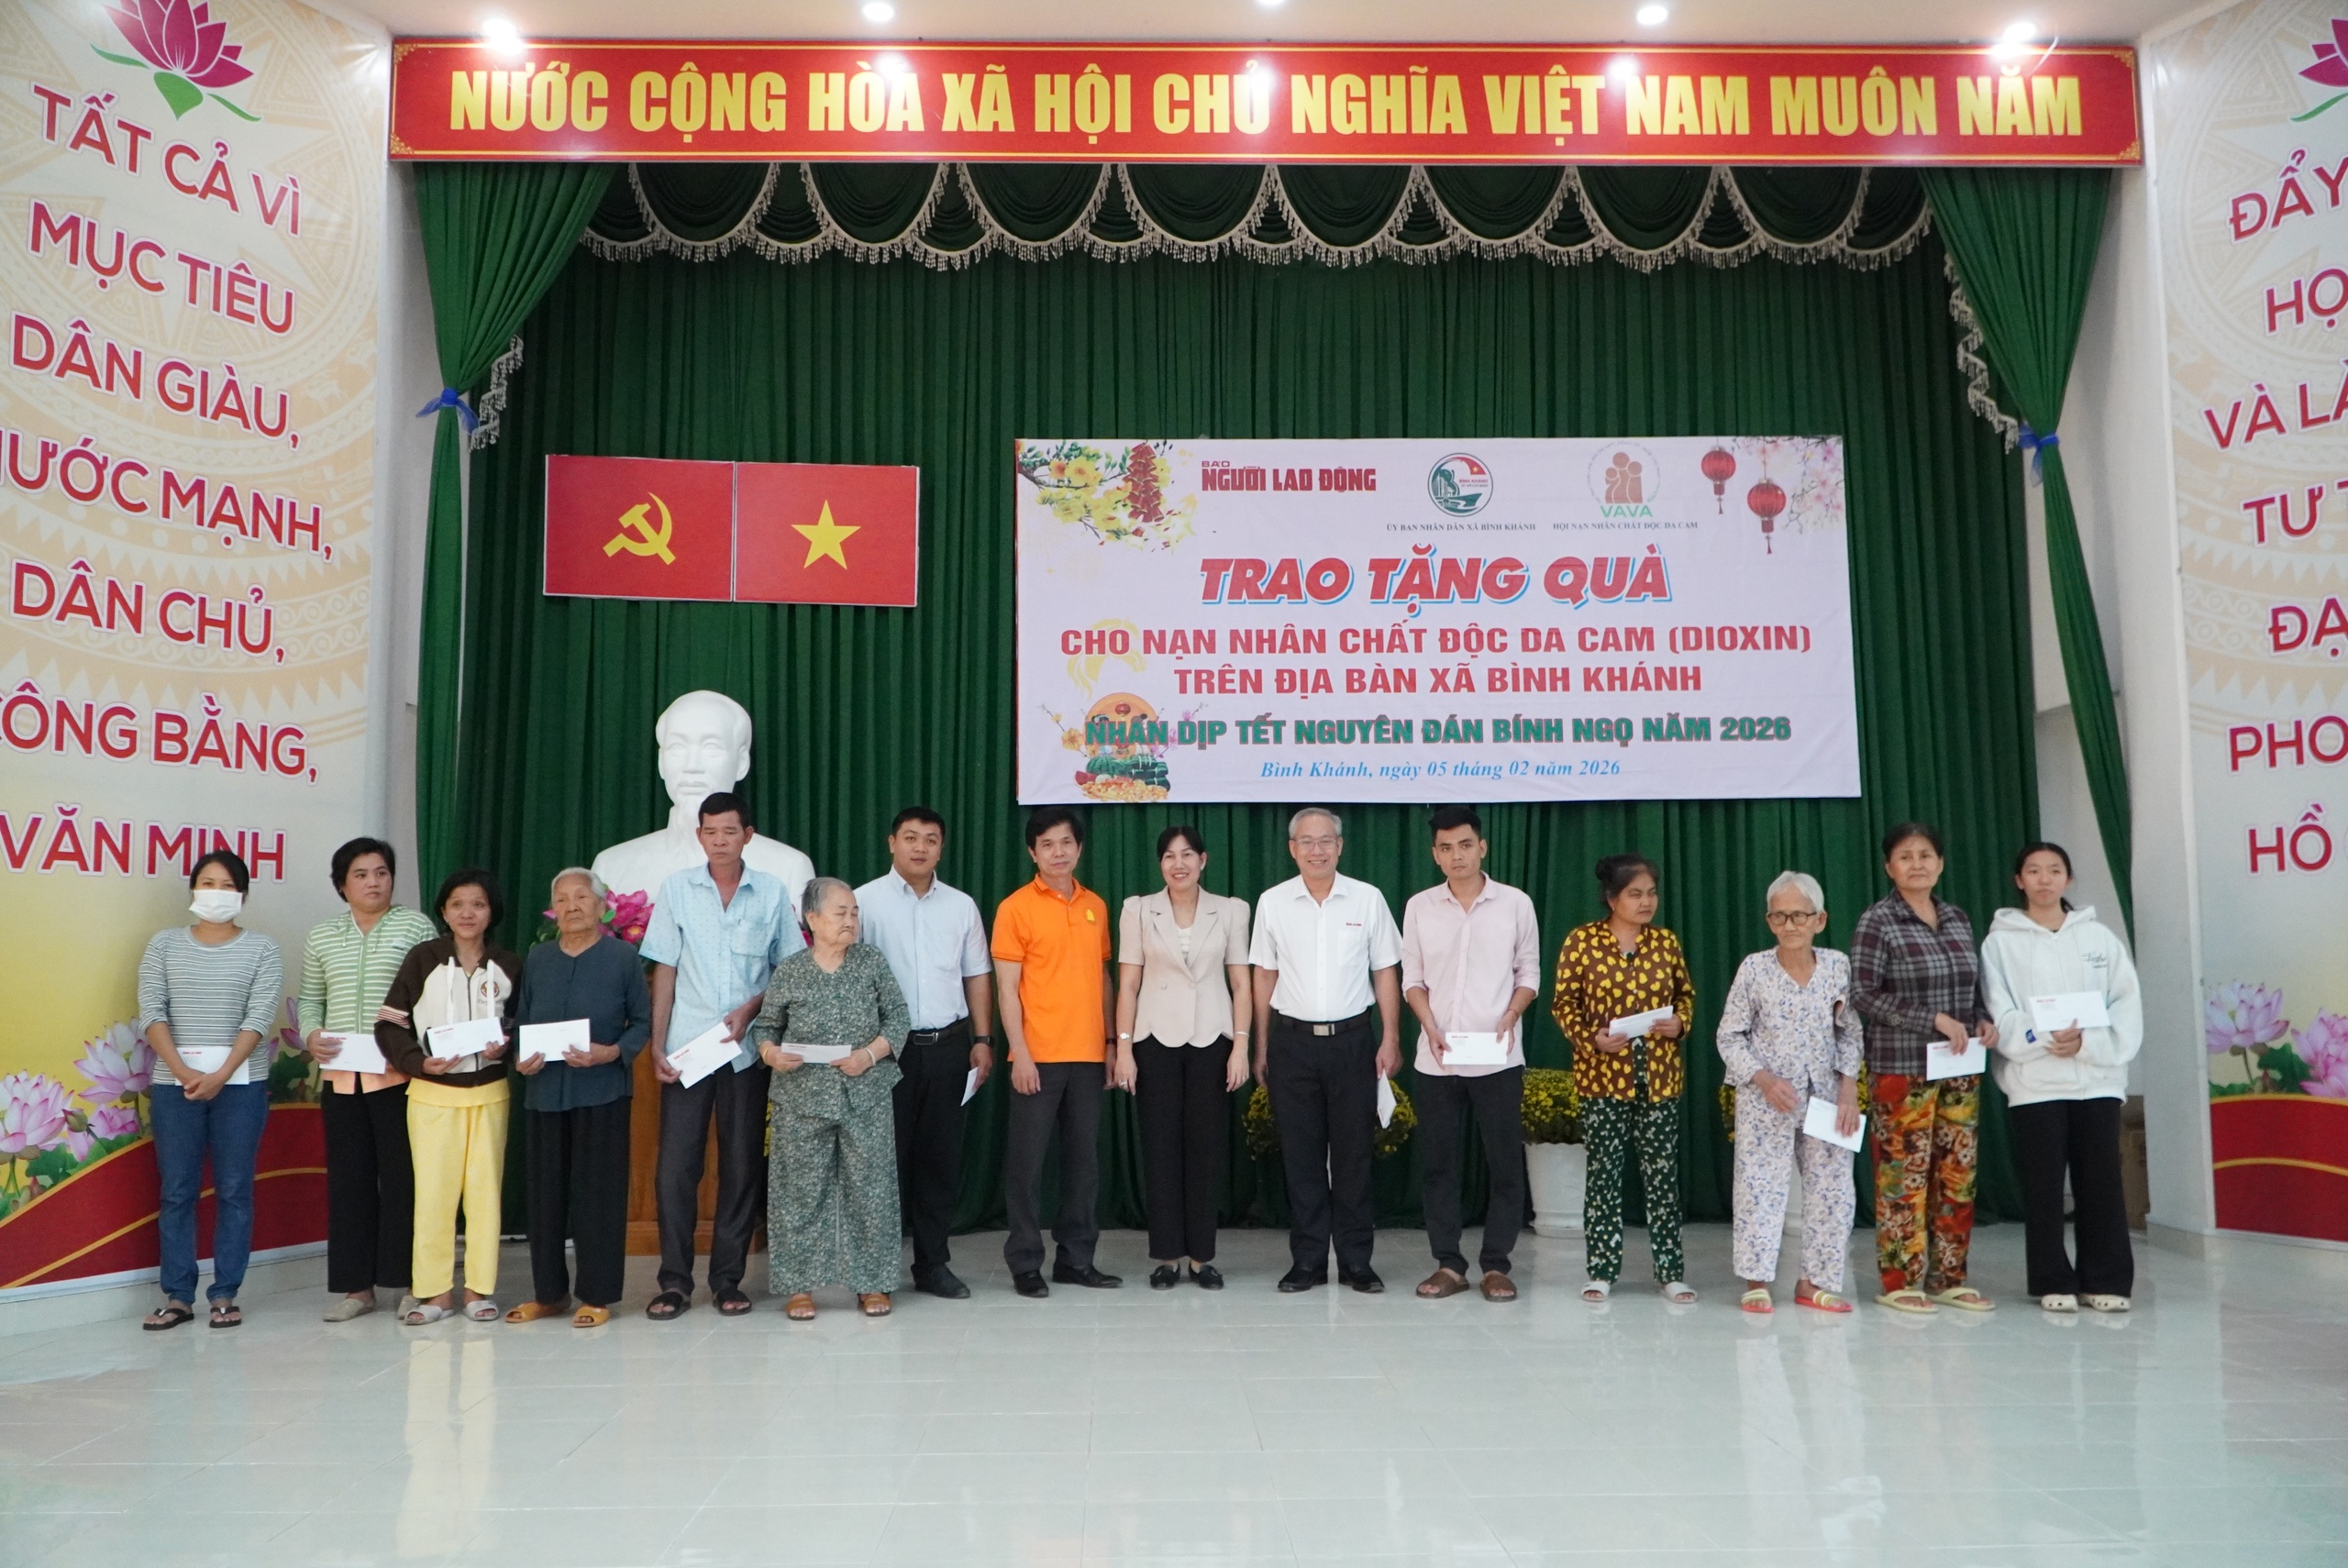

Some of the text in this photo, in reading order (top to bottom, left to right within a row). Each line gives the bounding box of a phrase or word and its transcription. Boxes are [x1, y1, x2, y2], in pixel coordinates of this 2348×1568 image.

[449, 60, 2082, 147] NƯỚC CỘNG HÒA XÃ HỘI CHỦ NGHĨA VIỆT NAM MUÔN NĂM
[33, 84, 299, 236] TẤT CẢ VÌ
[2229, 149, 2348, 241] ĐẨY
[30, 201, 294, 334] MỤC TIÊU
[12, 314, 299, 448] DÂN GIÀU,
[2204, 383, 2287, 449] VÀ
[0, 430, 332, 560] ƯỚC MẠNH,
[1202, 465, 1377, 493] NGƯỜI LAO ĐỘNG
[1600, 505, 1654, 518] VAVA
[2243, 485, 2323, 544] TƯ
[12, 560, 284, 663] DÂN CHỦ,
[1200, 543, 1672, 618] TRAO TẶNG QUÀ
[1060, 619, 1811, 660] CHO NẠN NHÂN CHẤT ĐỘC DA CAM (DIOXIN)
[1174, 661, 1701, 700] TRÊN ĐỊA BÀN XÃ BÌNH KHÁNH
[0, 681, 317, 783] ÔNG BẰNG,
[1177, 720, 1227, 750] DỊP
[1235, 712, 1286, 745] TẾT
[1294, 714, 1414, 745] NGUYÊN
[1421, 714, 1483, 744] ĐÁN
[1492, 713, 1564, 744] BÍNH
[1572, 717, 1634, 747] NGỌ
[1642, 712, 1711, 742] NĂM
[1720, 716, 1791, 741] 2026
[2229, 715, 2348, 772] PHO
[1260, 760, 1621, 781] Bình Khánh, ngày 05 tháng 02 năm 2026
[0, 806, 131, 874] VĂN
[2248, 803, 2332, 874] HỒ
